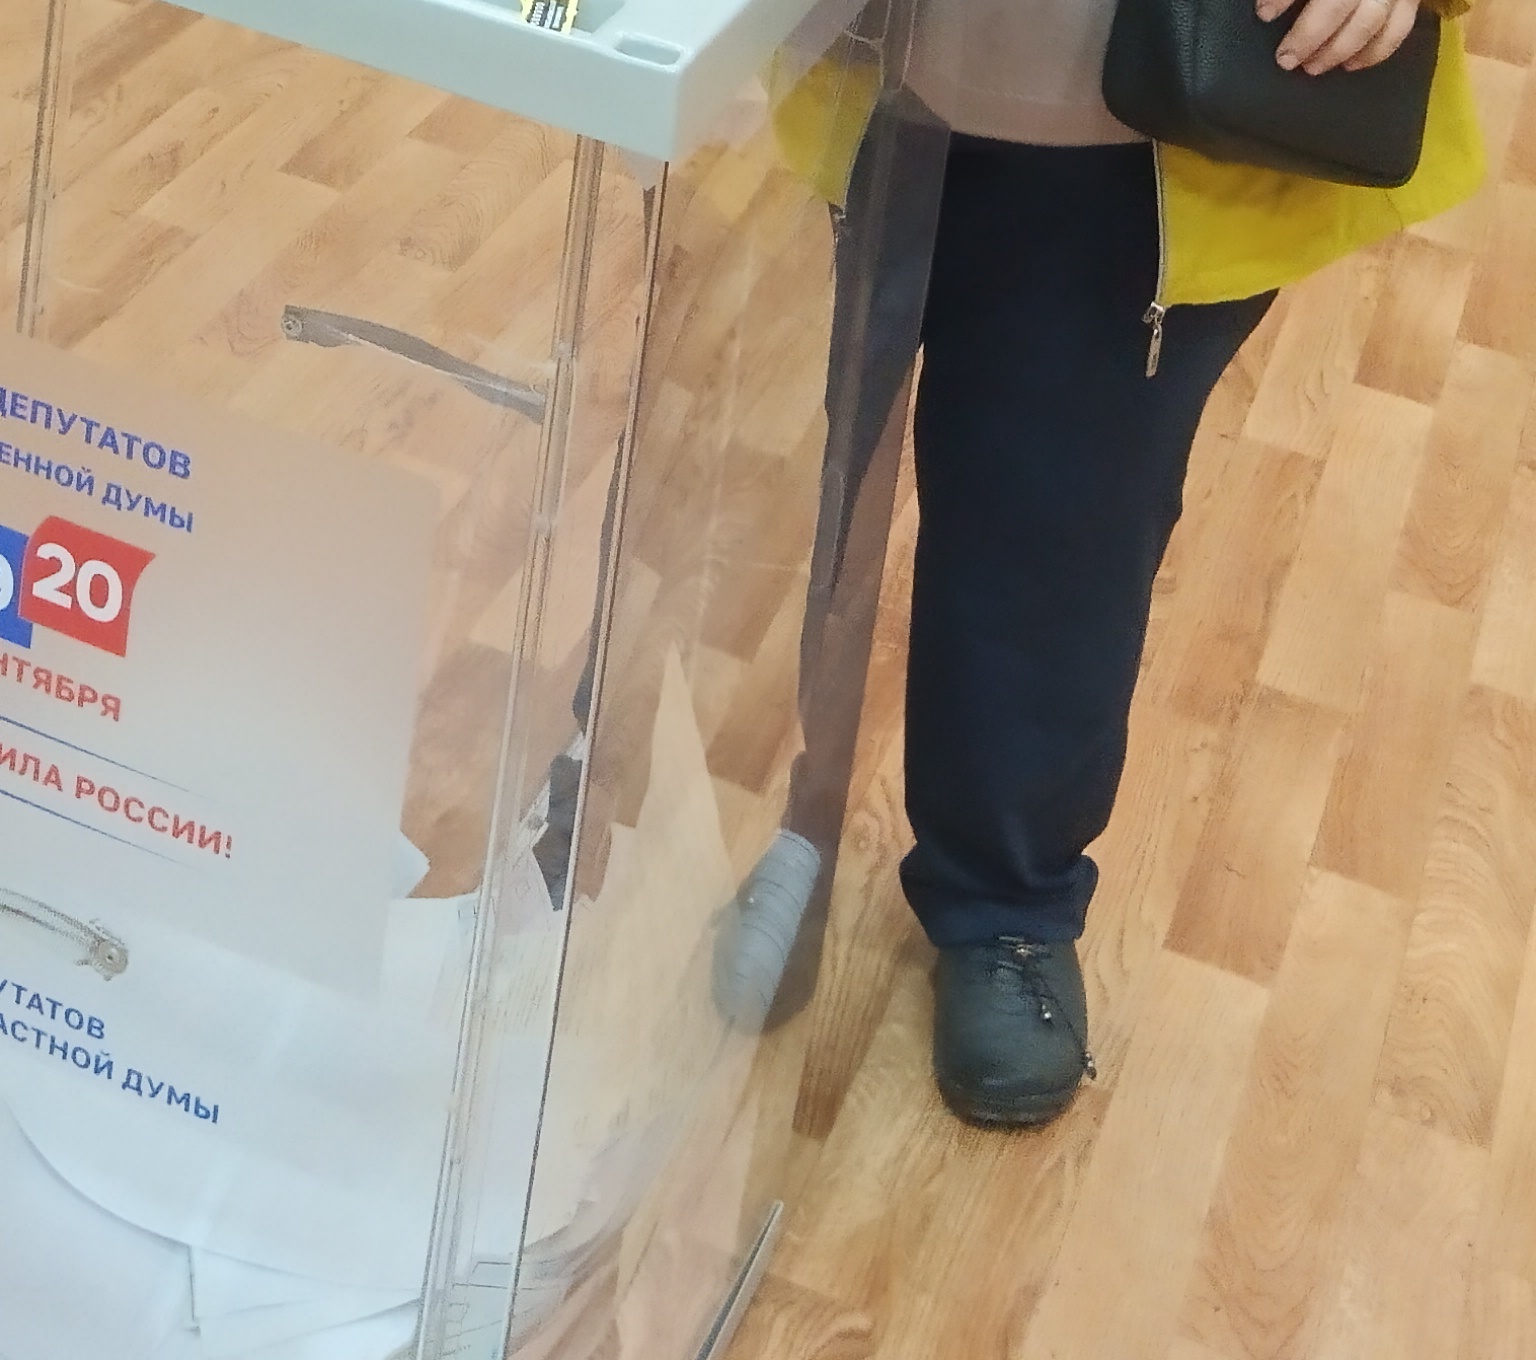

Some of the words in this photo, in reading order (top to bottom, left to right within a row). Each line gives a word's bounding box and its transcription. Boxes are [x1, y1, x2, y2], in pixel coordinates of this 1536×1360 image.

[102, 482, 193, 533] ДУМЫ
[33, 543, 123, 622] 20
[74, 776, 233, 858] РОССИИ!
[121, 1068, 219, 1124] ДУМЫ
